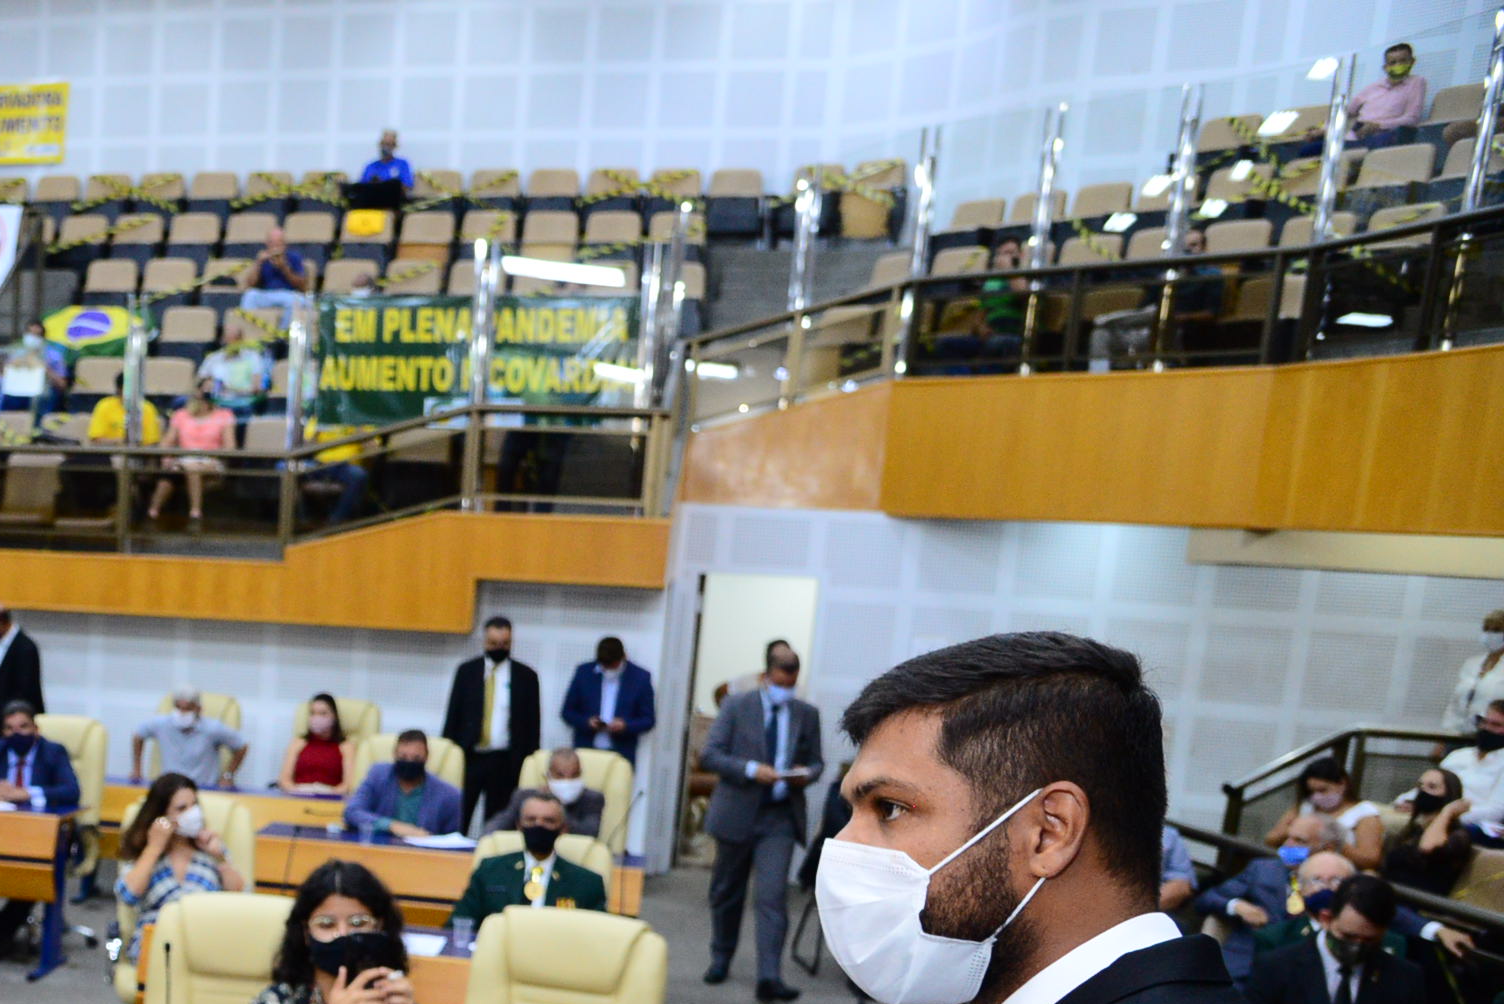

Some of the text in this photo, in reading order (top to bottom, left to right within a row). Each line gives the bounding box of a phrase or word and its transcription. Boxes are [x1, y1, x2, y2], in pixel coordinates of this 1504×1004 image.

[335, 306, 377, 343] EM
[382, 306, 473, 343] PLENA
[319, 354, 454, 393] AUMENTO
